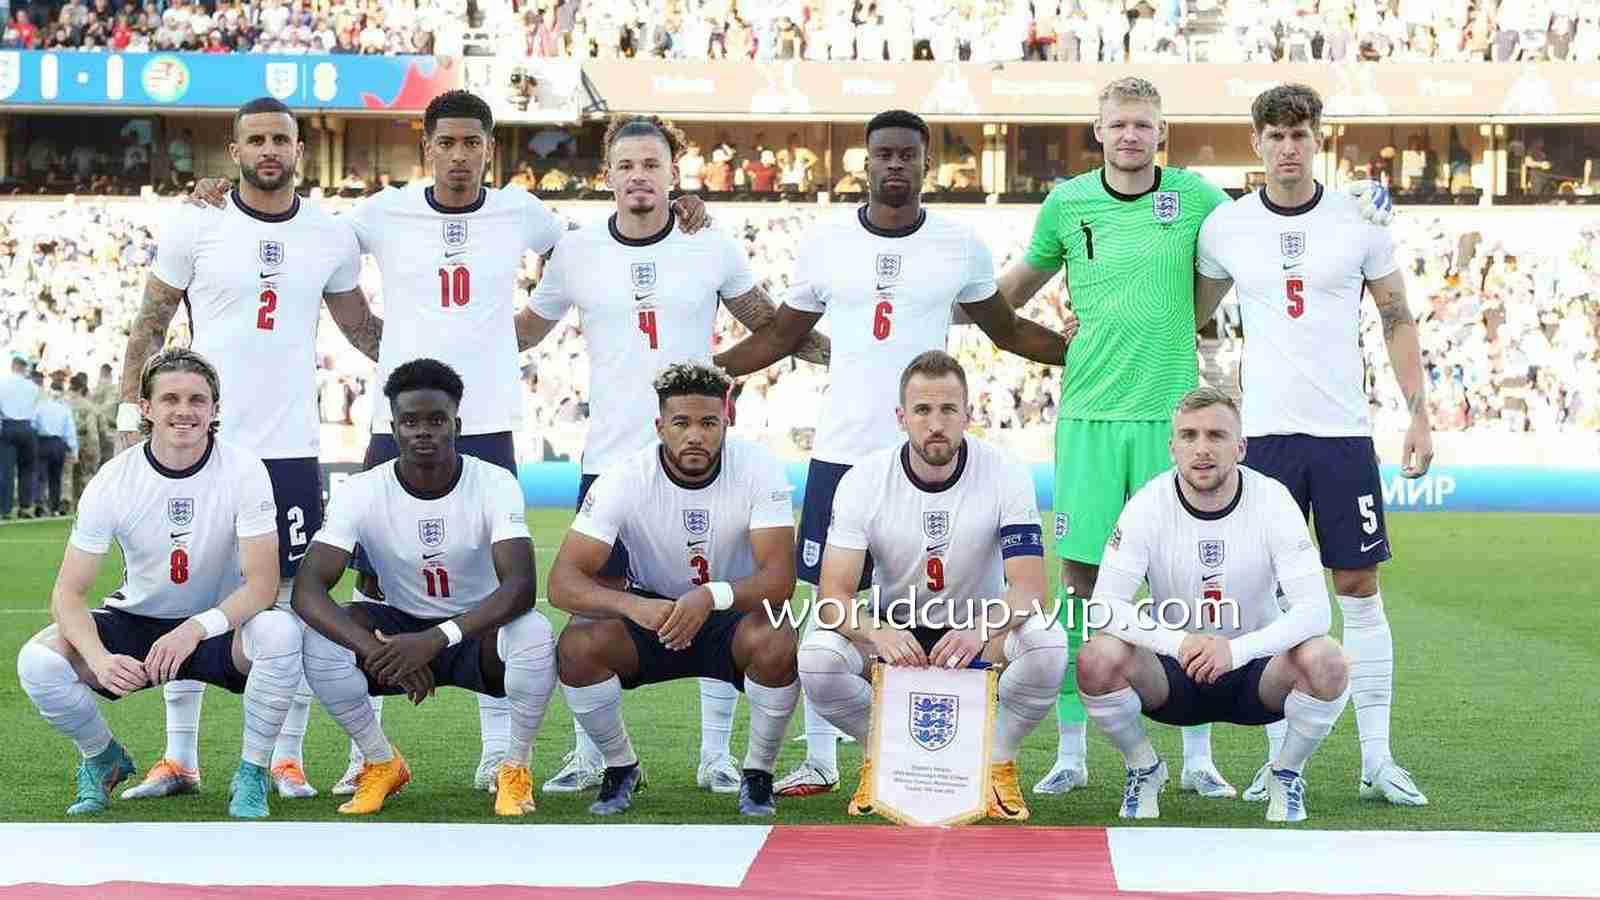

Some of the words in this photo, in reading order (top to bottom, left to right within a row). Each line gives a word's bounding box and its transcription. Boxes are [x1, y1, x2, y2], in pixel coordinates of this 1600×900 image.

[1082, 226, 1094, 260] 1
[438, 266, 470, 307] 10
[1286, 279, 1304, 318] 5
[256, 289, 278, 330] 2
[872, 301, 893, 341] 6
[638, 310, 658, 350] 4
[287, 505, 307, 546] 2
[1357, 494, 1378, 535] 5
[170, 549, 189, 584] 8
[422, 567, 450, 598] 11
[690, 556, 710, 586] 3
[926, 557, 945, 593] 9
